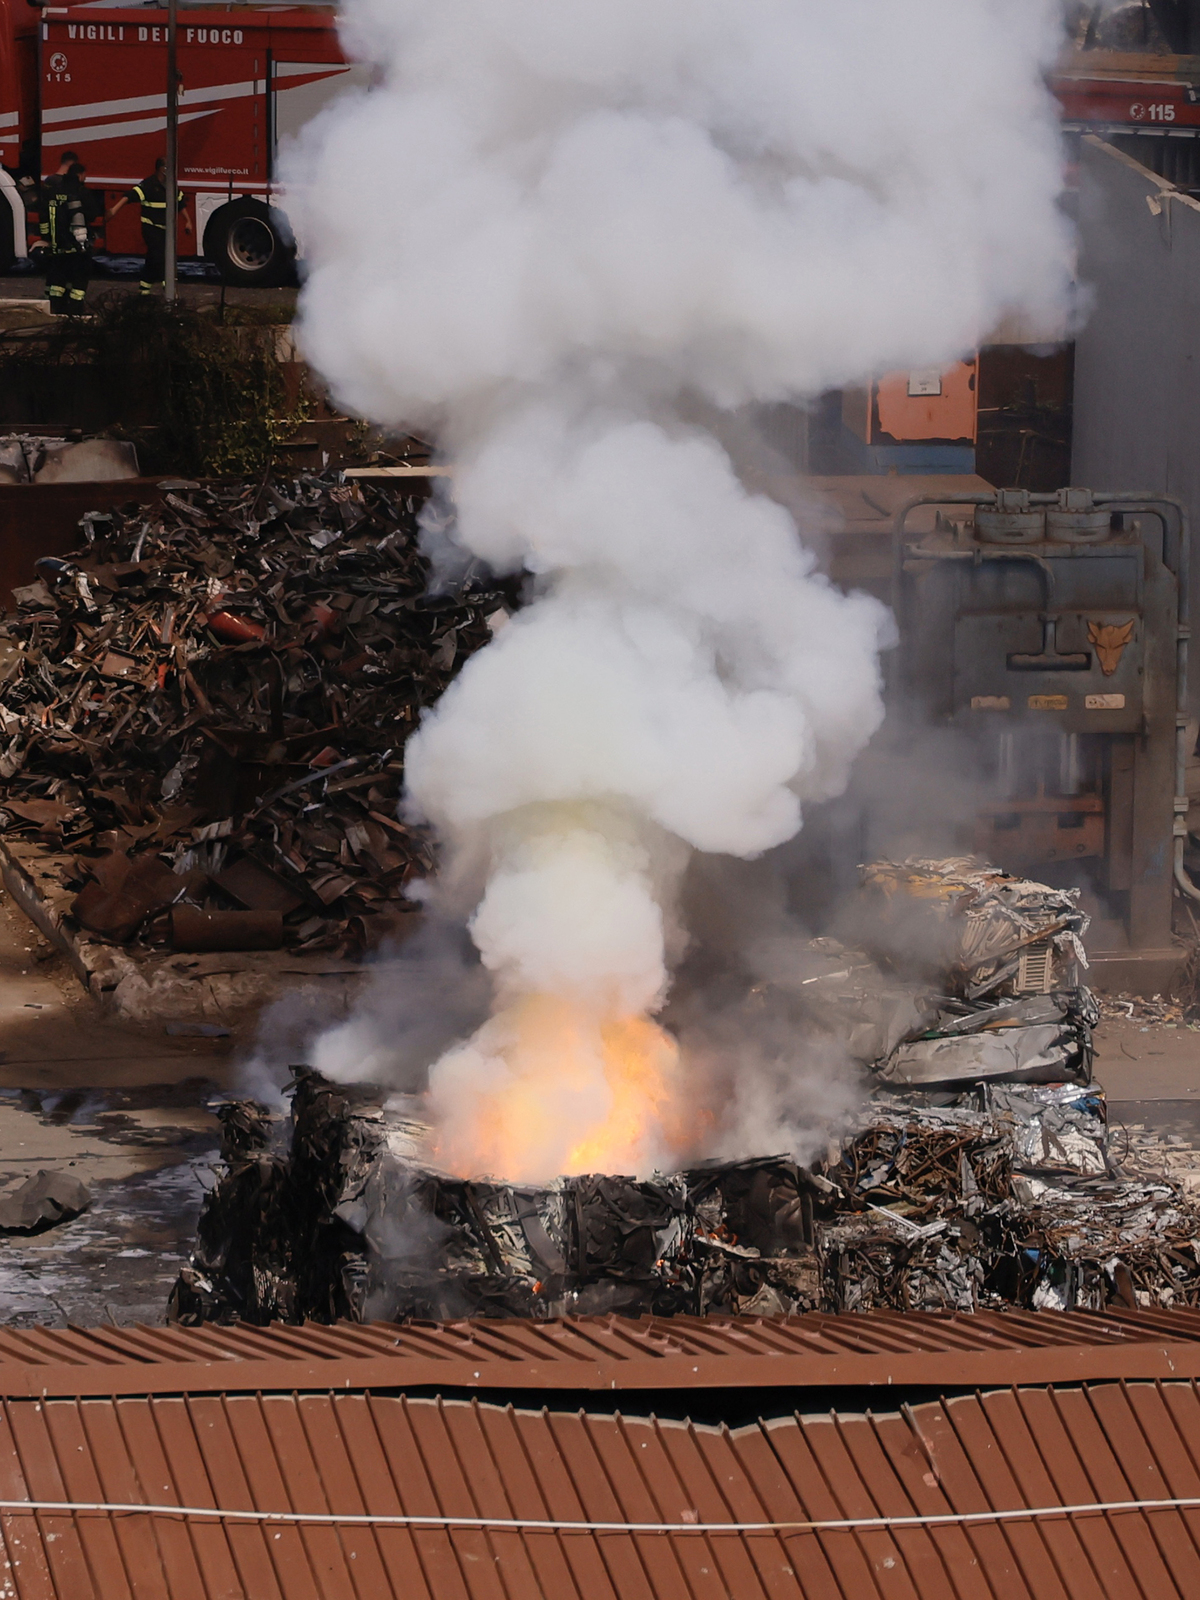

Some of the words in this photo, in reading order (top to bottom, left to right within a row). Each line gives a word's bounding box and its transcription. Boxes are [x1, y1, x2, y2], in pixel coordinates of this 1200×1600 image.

[68, 24, 124, 41] VIGILI
[187, 28, 244, 45] FUOCO
[46, 73, 72, 82] 115
[1148, 104, 1175, 121] 115
